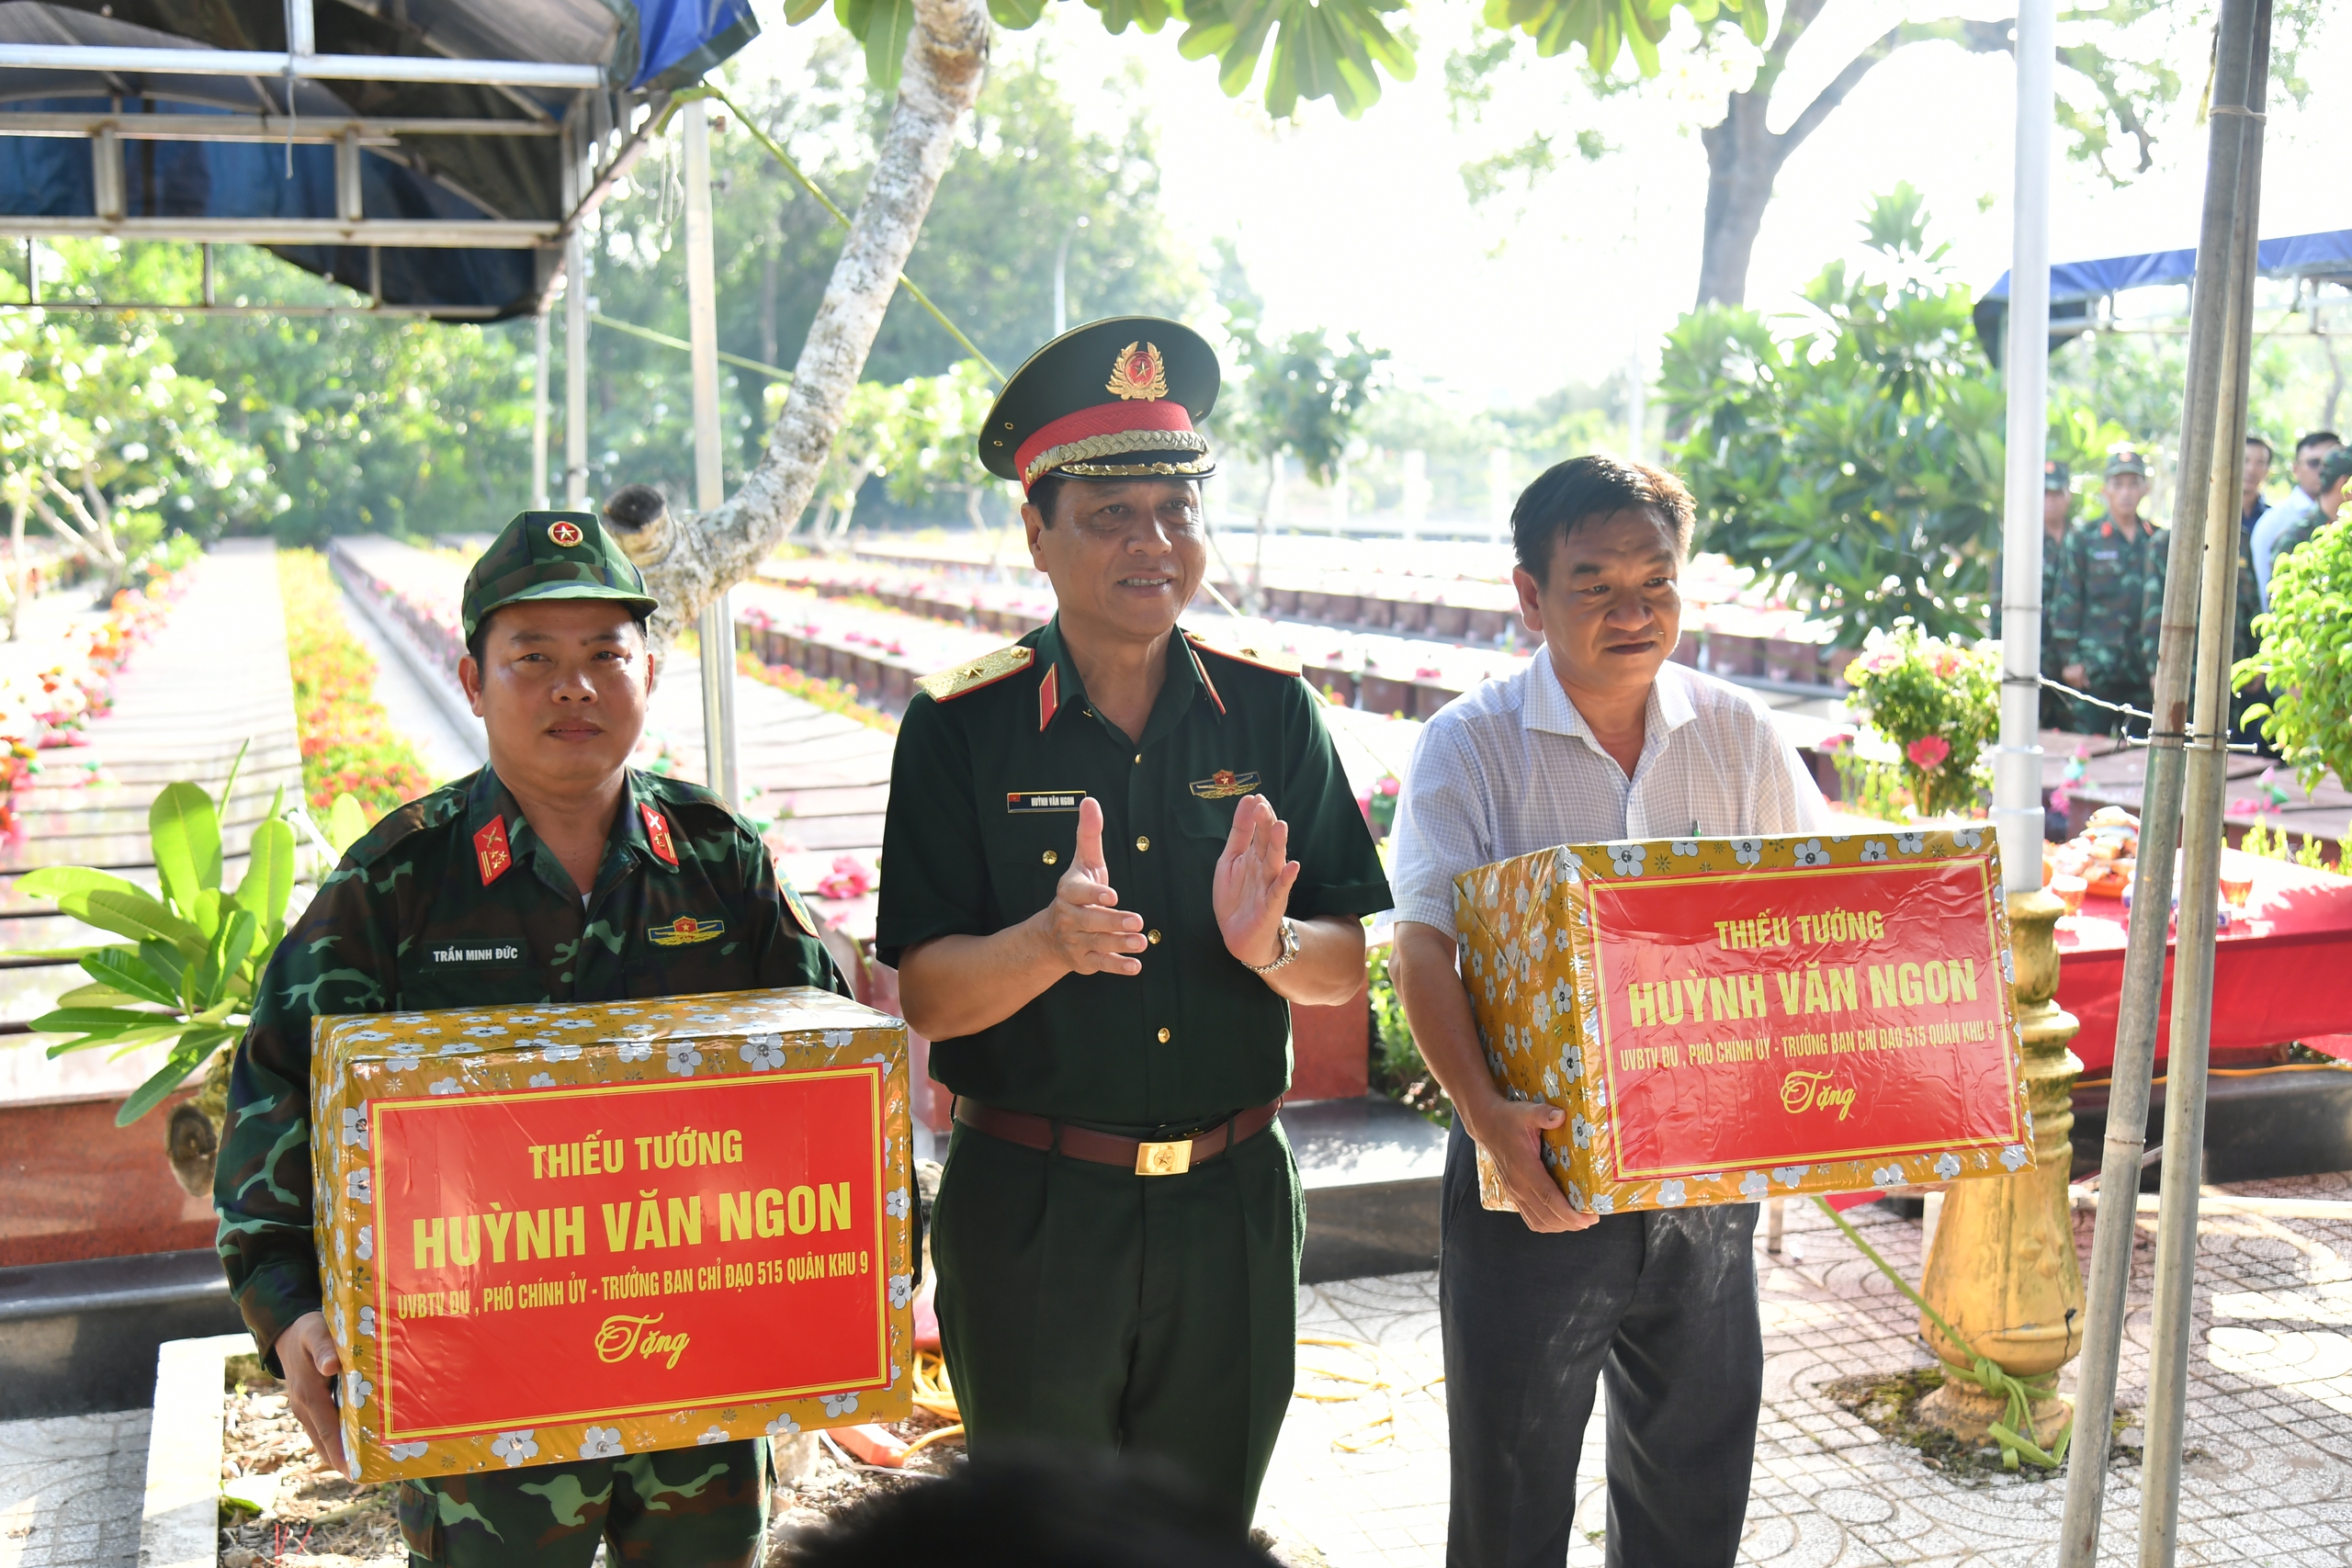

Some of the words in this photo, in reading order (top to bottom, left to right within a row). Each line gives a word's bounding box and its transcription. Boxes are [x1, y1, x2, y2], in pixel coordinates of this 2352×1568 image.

[433, 945, 463, 963] TRẦN
[465, 949, 492, 961] MINH
[495, 945, 518, 959] ĐỨC
[1713, 908, 1791, 950] THIẾU
[1797, 907, 1884, 945] TƯỚNG
[1628, 969, 1768, 1027] HUỲNH
[1776, 961, 1858, 1015] VĂN
[1868, 958, 1977, 1009] NGON
[1620, 1047, 1658, 1071] UVBTV
[1661, 1045, 1679, 1067] ĐU
[1689, 1039, 1713, 1066] PHÓ
[1716, 1036, 1753, 1063] CHÍNH
[1755, 1031, 1770, 1060] ỦY
[1781, 1027, 1828, 1057] TRƯỞNG
[1830, 1031, 1855, 1054] BAN
[1857, 1021, 1877, 1051] CHỈ
[1880, 1026, 1903, 1054] ĐẠO
[1905, 1025, 1926, 1047] 515
[1928, 1019, 1960, 1047] QUÂN
[1962, 1020, 1984, 1043] KHU
[1987, 1020, 1996, 1041] 9
[1781, 1069, 1856, 1121] Tặng
[528, 1128, 624, 1179] THIẾU
[635, 1127, 743, 1170] TƯỚNG
[413, 1201, 585, 1269] HUỲNH
[603, 1189, 702, 1253] VĂN
[720, 1181, 852, 1242] NGON
[398, 1292, 445, 1319] UVBTV
[450, 1290, 469, 1315] ĐU
[483, 1280, 514, 1312] PHÓ
[518, 1277, 564, 1309] CHÍNH
[569, 1271, 587, 1303] ỦY
[602, 1265, 659, 1301] TRƯỞNG
[663, 1268, 694, 1295] BAN
[697, 1257, 721, 1292] CHỈ
[725, 1262, 753, 1292] ĐẠO
[758, 1259, 783, 1285] 515
[787, 1251, 824, 1284] QUÂN
[829, 1251, 856, 1277] KHU
[860, 1250, 868, 1274] 9
[594, 1312, 690, 1370] Tặng
